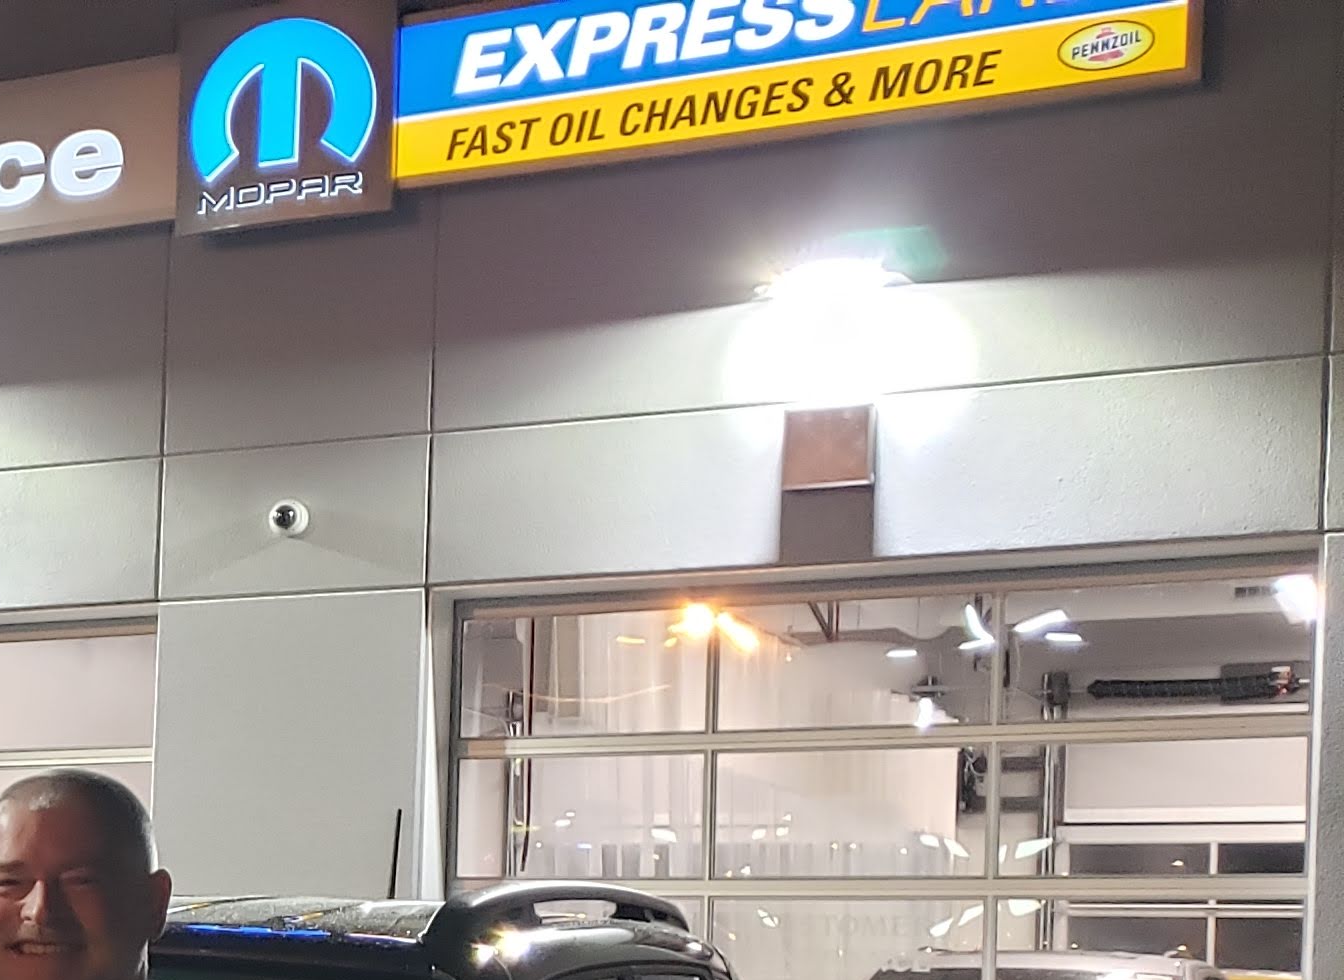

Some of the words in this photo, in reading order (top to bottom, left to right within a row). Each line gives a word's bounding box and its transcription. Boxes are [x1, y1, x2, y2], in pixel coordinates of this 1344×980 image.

[1071, 29, 1142, 60] PENNZOIL
[446, 116, 541, 161] FAST
[548, 108, 606, 146] OIL
[618, 77, 814, 137] CHANGES
[823, 71, 856, 107] &
[868, 49, 1003, 101] MORE
[196, 171, 364, 215] MOPAR
